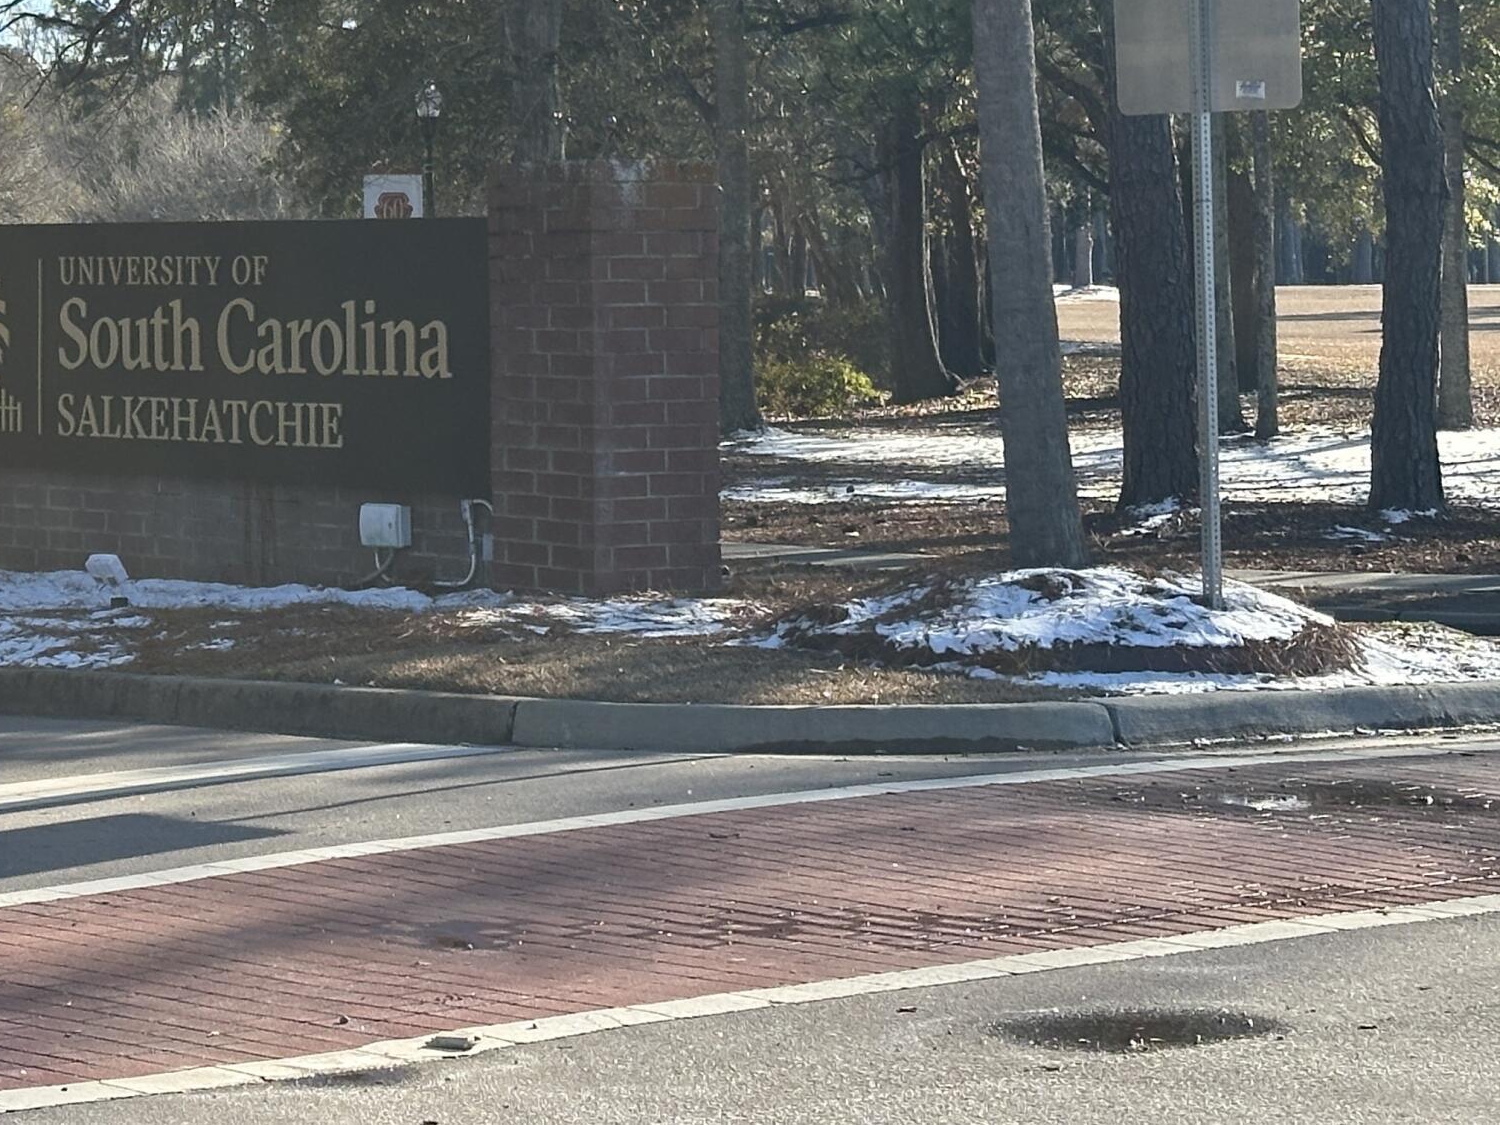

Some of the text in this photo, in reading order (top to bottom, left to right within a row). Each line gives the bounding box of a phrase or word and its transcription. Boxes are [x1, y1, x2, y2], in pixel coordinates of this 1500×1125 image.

[58, 255, 268, 286] UNIVERSITY OF
[58, 297, 452, 378] South Carolina
[58, 393, 343, 448] SALKEHATCHIE
